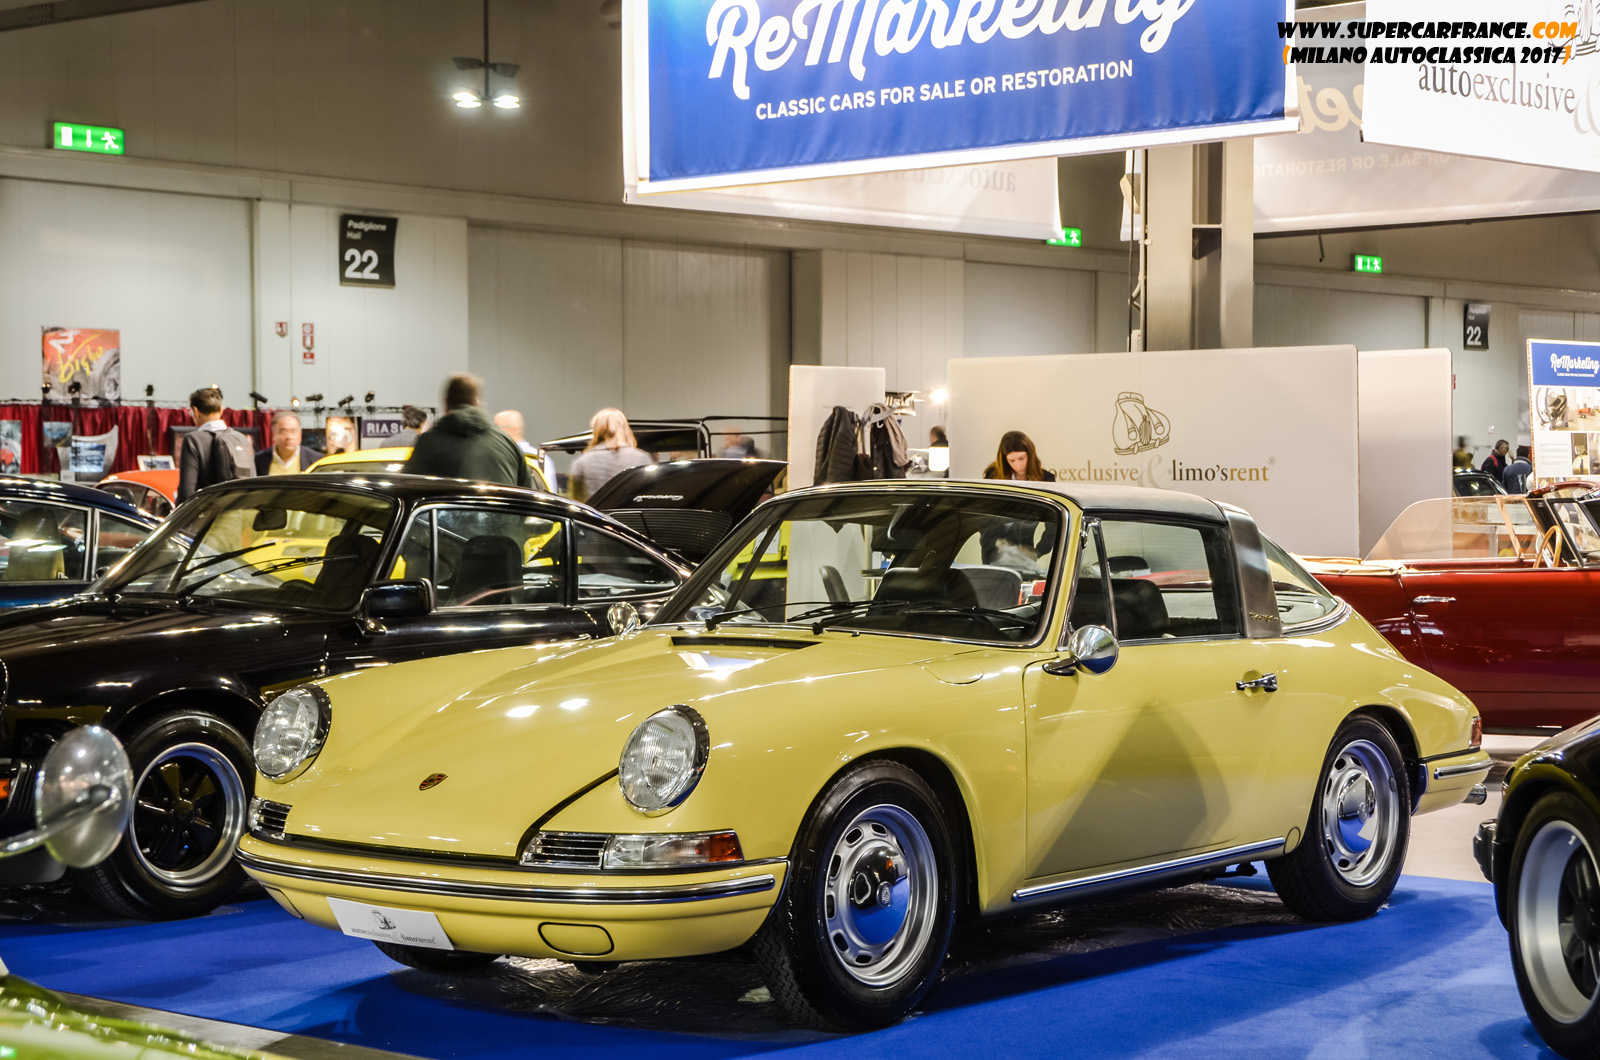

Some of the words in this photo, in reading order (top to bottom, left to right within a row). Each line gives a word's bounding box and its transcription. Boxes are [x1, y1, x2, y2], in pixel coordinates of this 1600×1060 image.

[756, 96, 826, 120] CLASSIC
[829, 90, 875, 111] CARS
[880, 86, 915, 106] FOR
[919, 79, 966, 101] SALE
[970, 76, 996, 96] OR
[1001, 59, 1134, 92] RESTORATION
[1418, 62, 1576, 114] autoexclusive
[346, 231, 362, 240] Hall
[347, 220, 387, 232] Padiglione
[344, 248, 380, 280] 22
[1466, 325, 1482, 346] 22
[1550, 353, 1600, 375] ReMarketing
[1049, 459, 1139, 482] oexclusive
